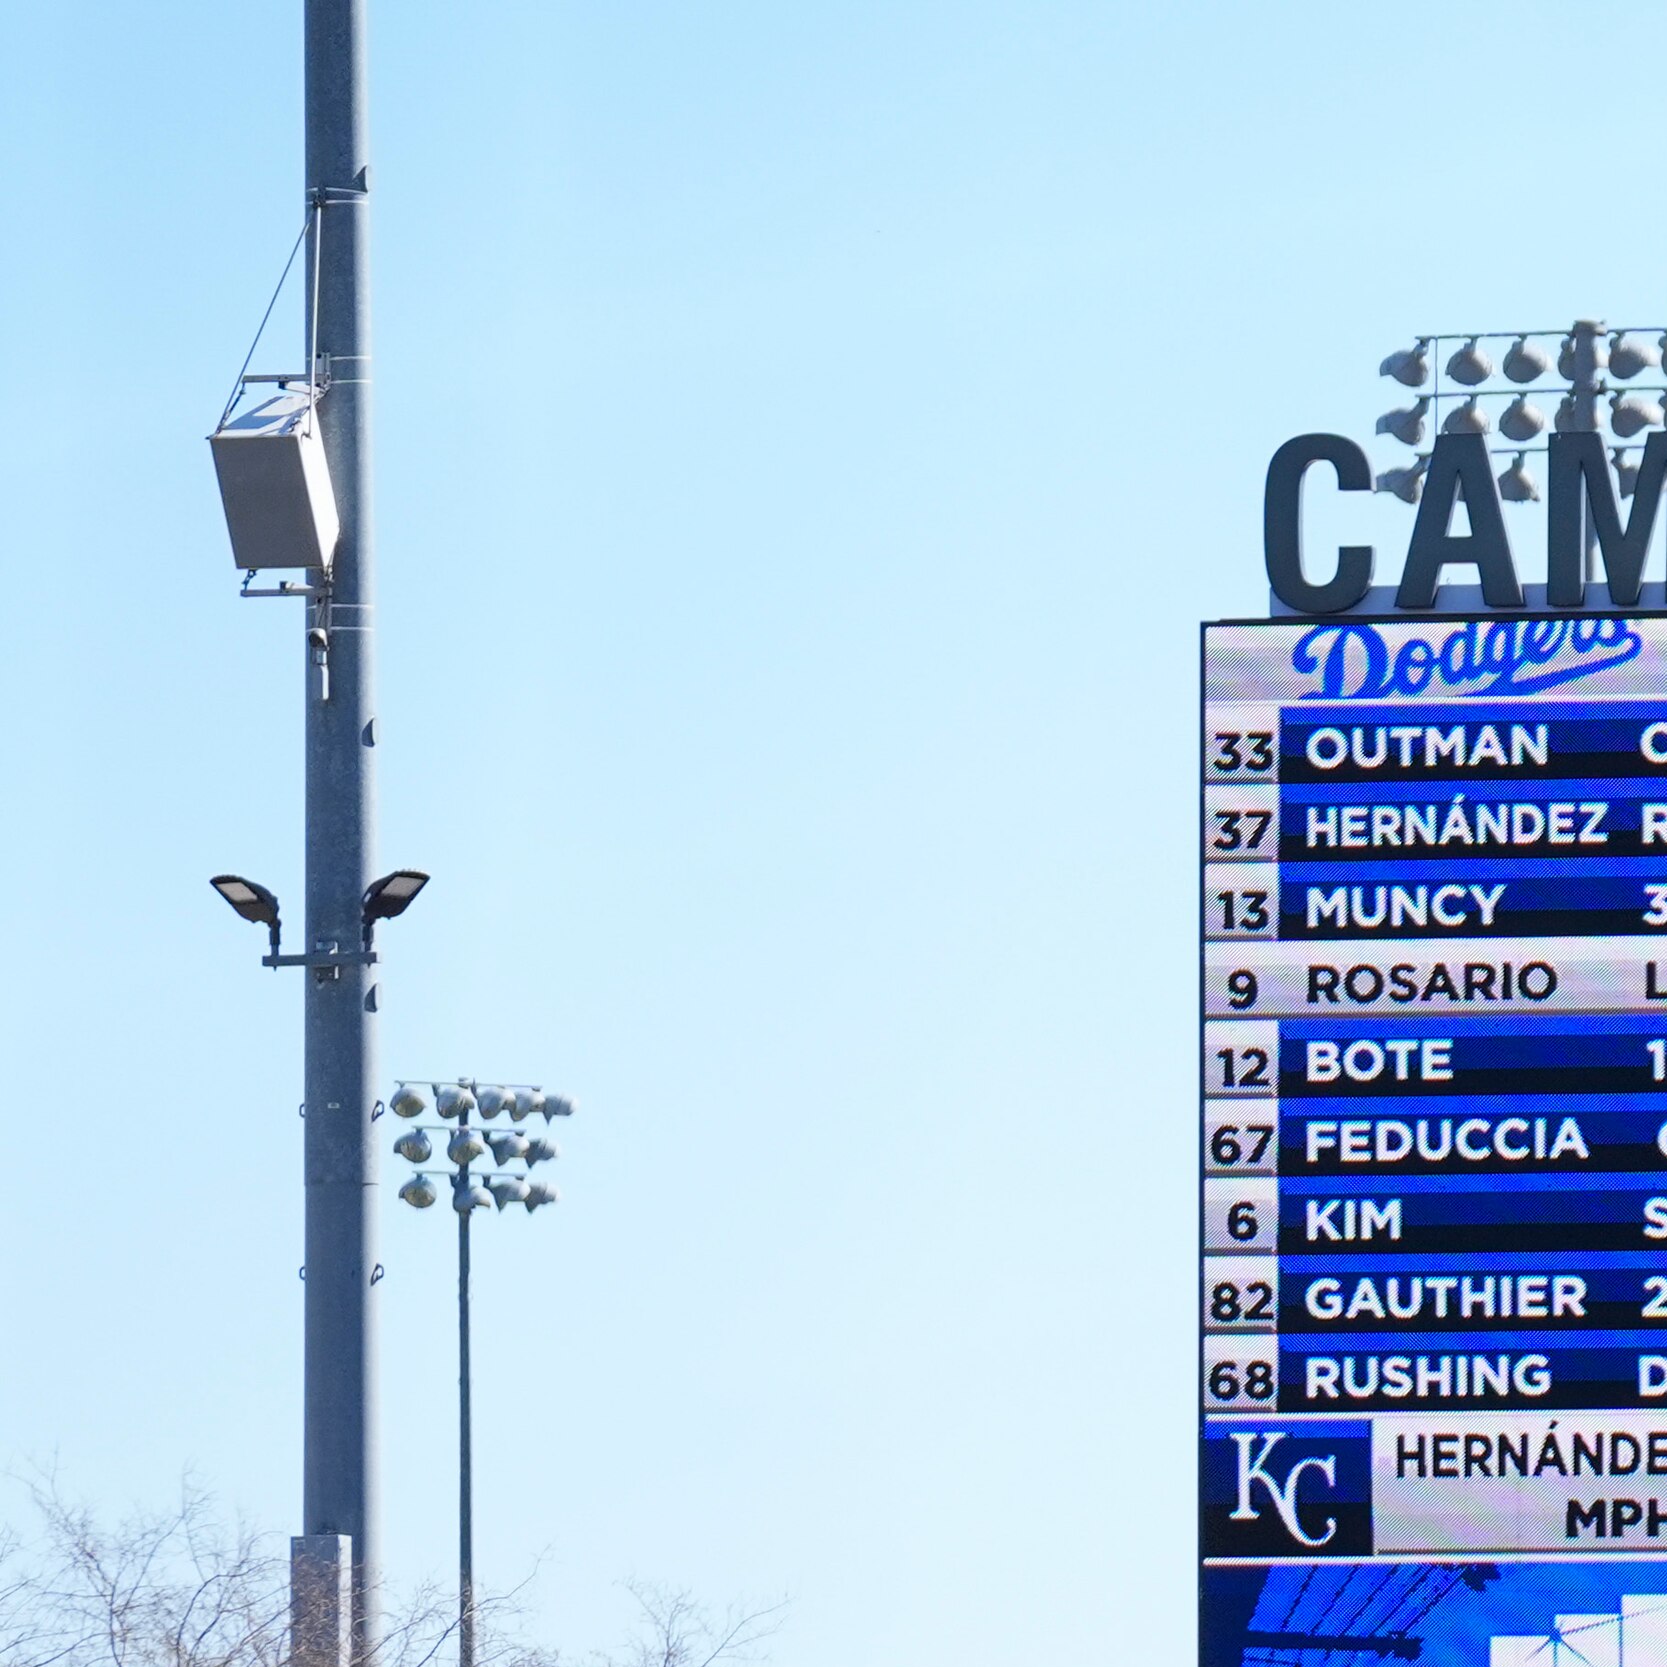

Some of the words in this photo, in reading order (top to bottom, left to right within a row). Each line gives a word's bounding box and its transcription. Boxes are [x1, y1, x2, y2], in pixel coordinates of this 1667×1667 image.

[1291, 619, 1641, 699] Dodgers
[1213, 731, 1274, 773] 33
[1305, 722, 1551, 770] OUTMAN
[1213, 808, 1273, 851] 37
[1305, 793, 1610, 848] HERNÁNDEZ
[1217, 889, 1270, 931] 13
[1305, 883, 1507, 928] MUNCY
[1227, 968, 1258, 1010] 9
[1306, 961, 1558, 1002] ROSARIO
[1217, 1046, 1270, 1088] 12
[1306, 1039, 1454, 1083] BOTE
[1210, 1123, 1274, 1166] 67
[1306, 1117, 1590, 1163] FEDUCCIA
[1227, 1200, 1258, 1241] 6
[1305, 1198, 1403, 1242] KIM
[1210, 1280, 1274, 1322] 82
[1305, 1275, 1588, 1320] GAUTHIER
[1208, 1358, 1274, 1402] 68
[1305, 1354, 1553, 1400] RUSHING
[1229, 1431, 1336, 1547] KC
